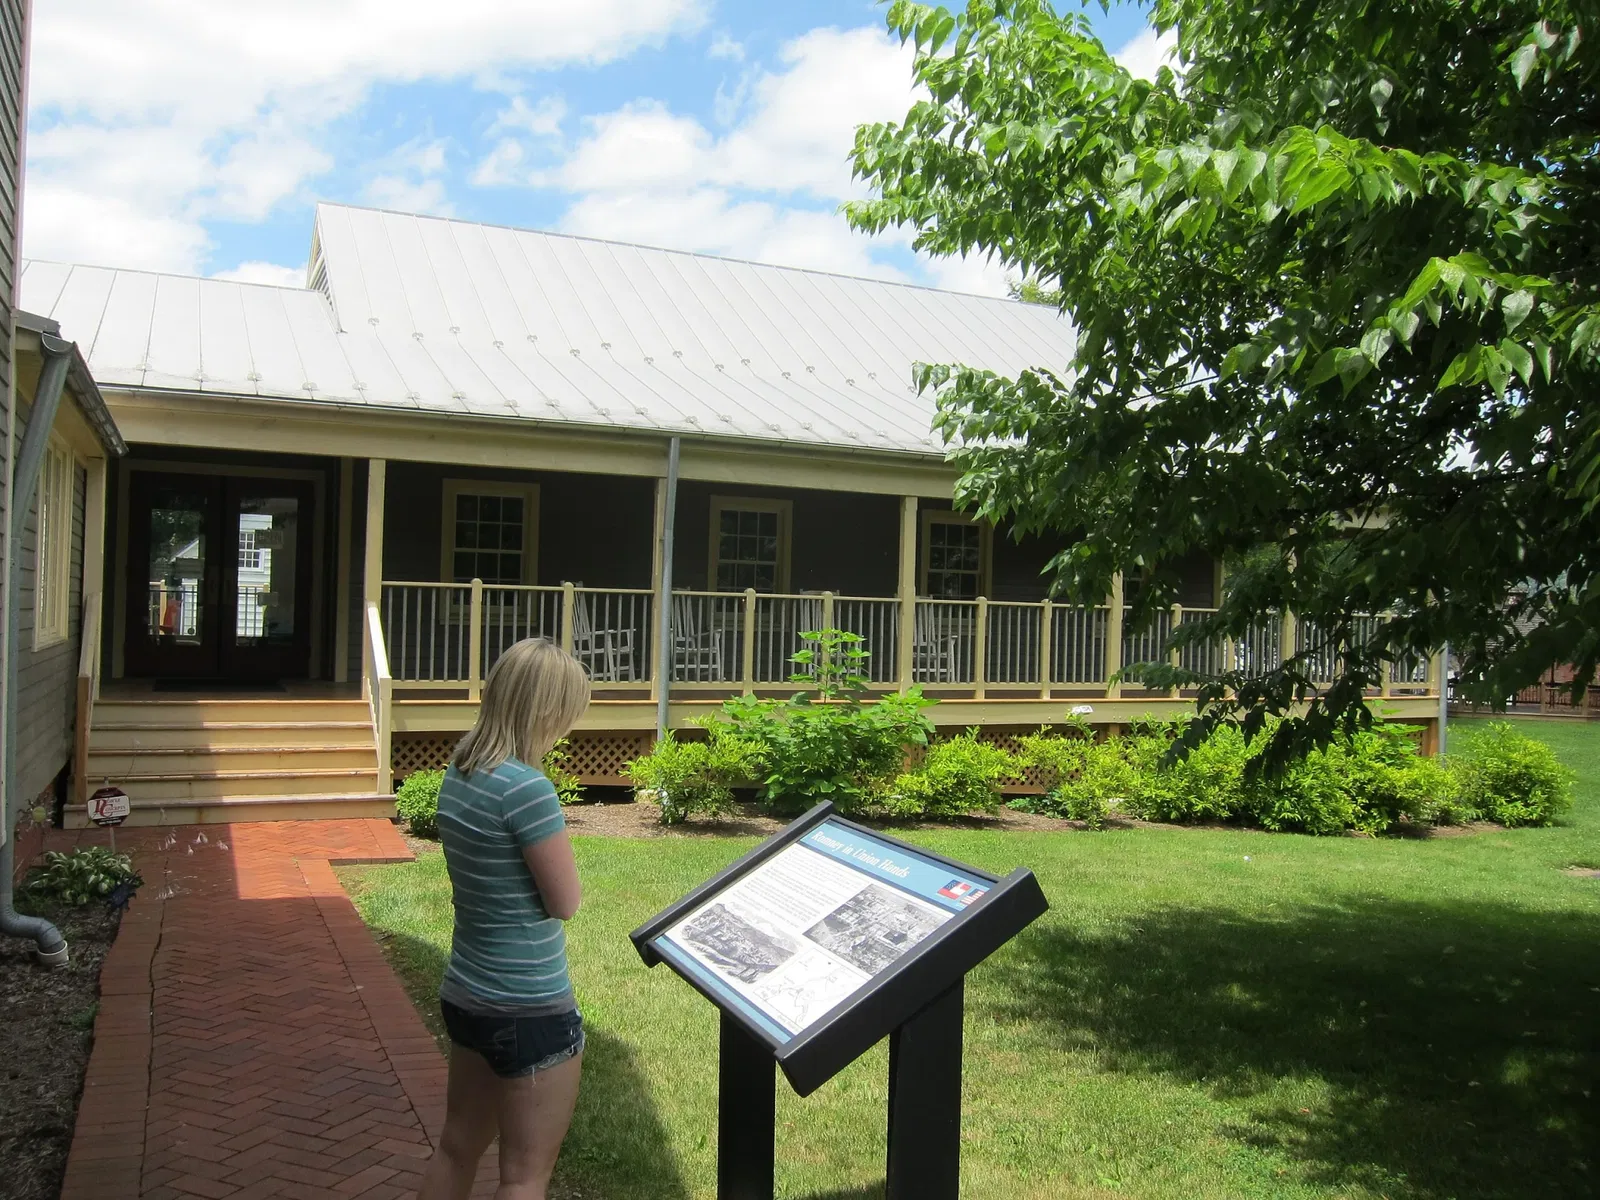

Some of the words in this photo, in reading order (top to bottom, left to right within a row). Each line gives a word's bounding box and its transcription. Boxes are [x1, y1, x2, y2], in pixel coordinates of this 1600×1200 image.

[811, 831, 843, 852] Romney
[842, 844, 853, 855] in
[852, 848, 879, 866] Union
[878, 859, 910, 878] Hands
